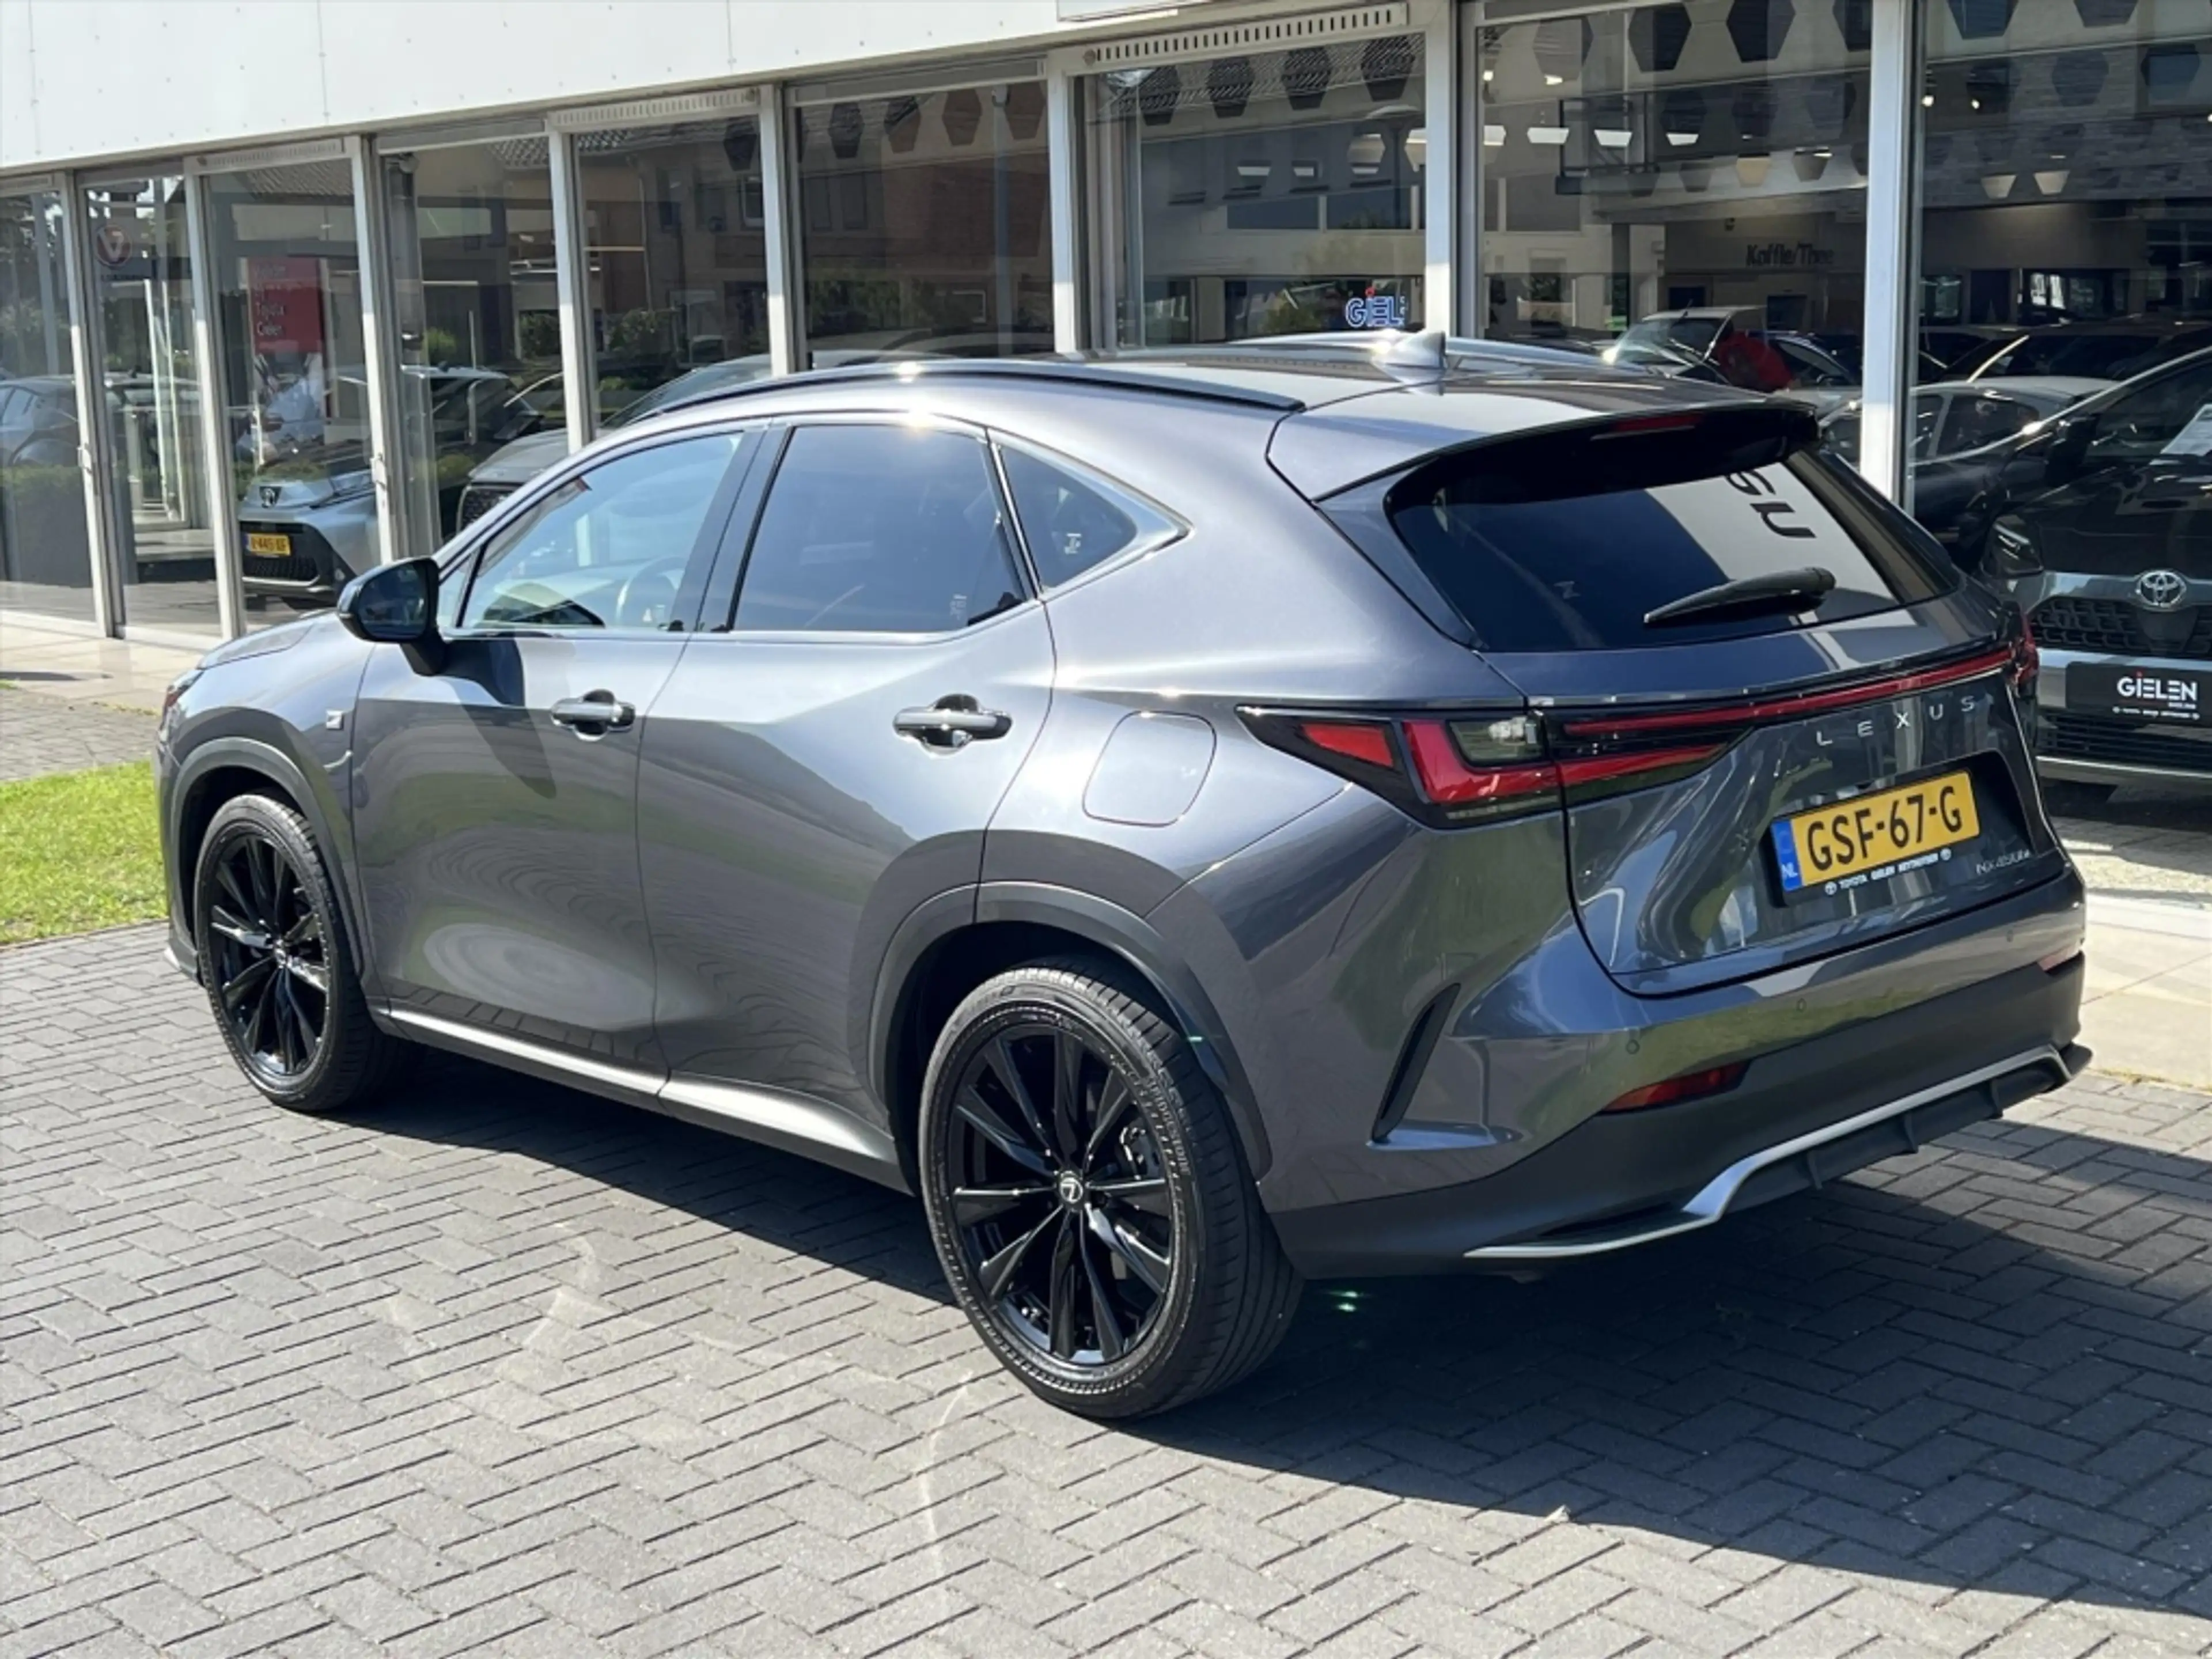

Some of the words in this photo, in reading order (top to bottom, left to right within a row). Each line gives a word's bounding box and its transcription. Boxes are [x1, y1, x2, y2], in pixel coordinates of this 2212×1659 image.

[1346, 287, 1405, 328] GIEL
[2116, 671, 2198, 701] GIELEN
[1816, 695, 1975, 746] LEXUS
[1807, 785, 1963, 872] GSF-67-G
[1781, 862, 1798, 880] NL
